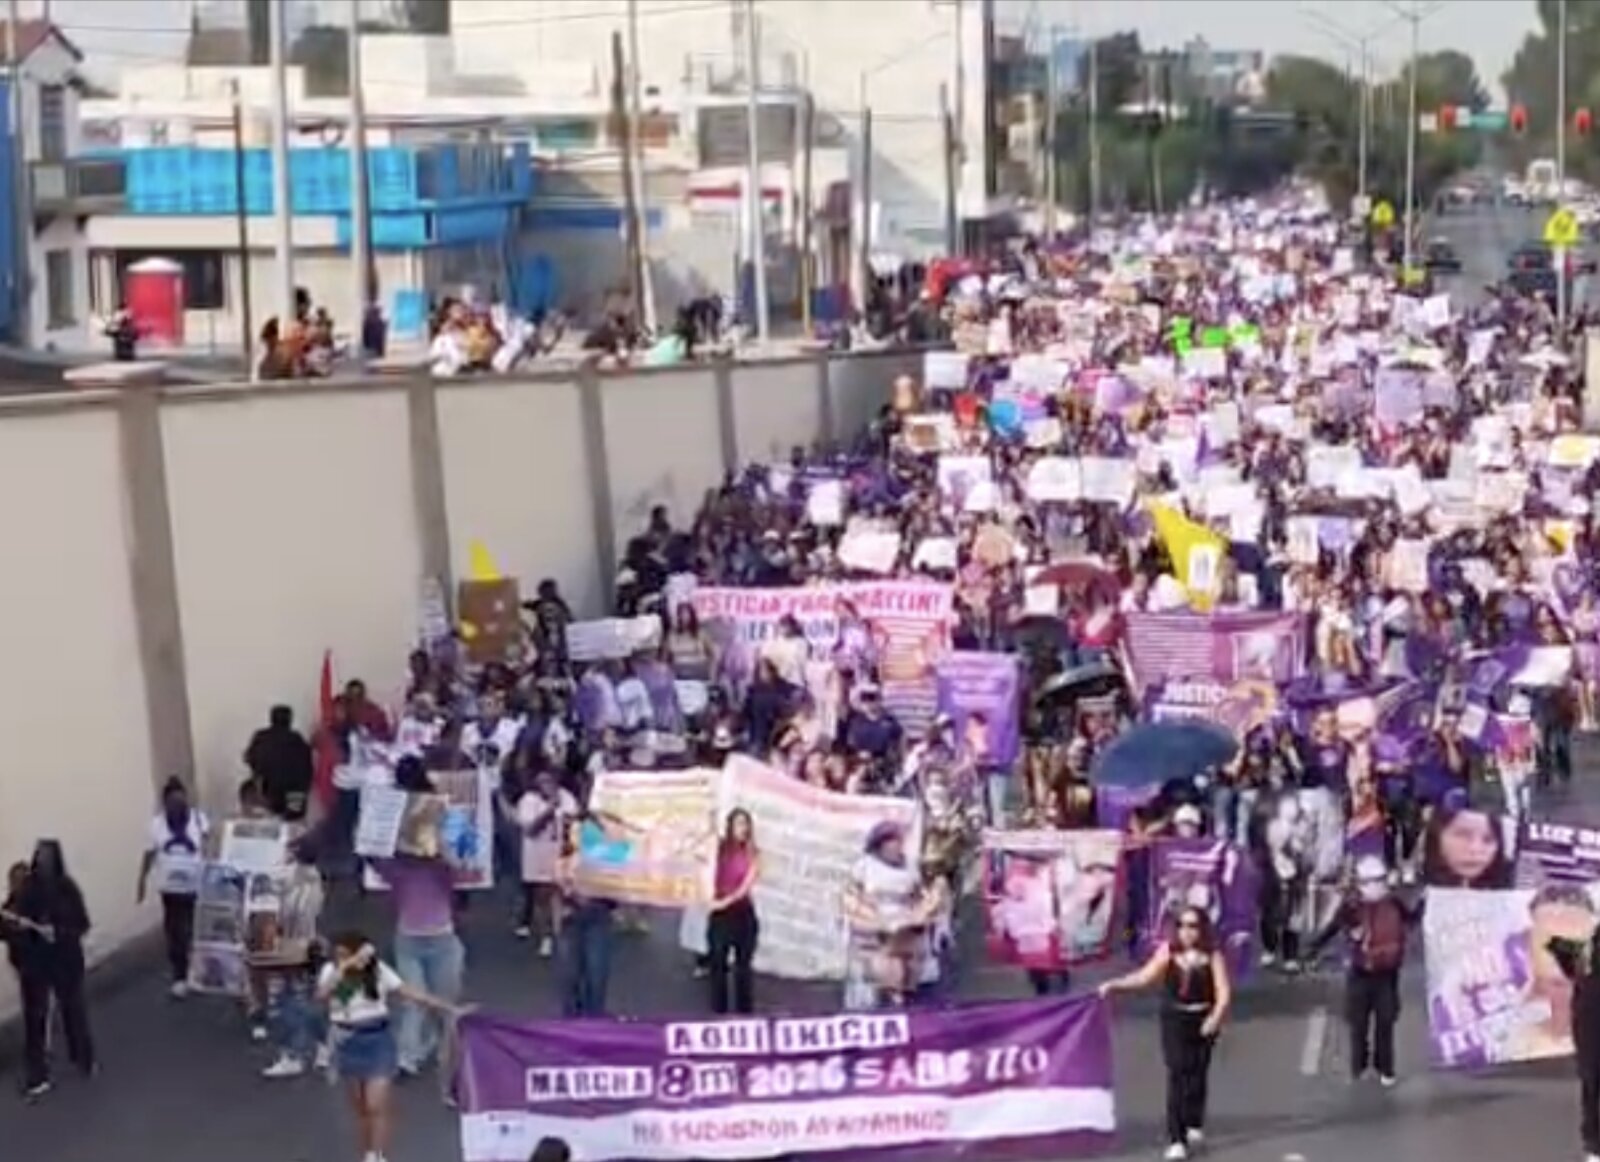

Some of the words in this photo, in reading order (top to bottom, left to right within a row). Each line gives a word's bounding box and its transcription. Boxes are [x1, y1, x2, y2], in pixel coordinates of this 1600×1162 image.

[778, 1016, 906, 1050] INICIA
[529, 1068, 650, 1098] MARCHA
[748, 1055, 846, 1097] 2026
